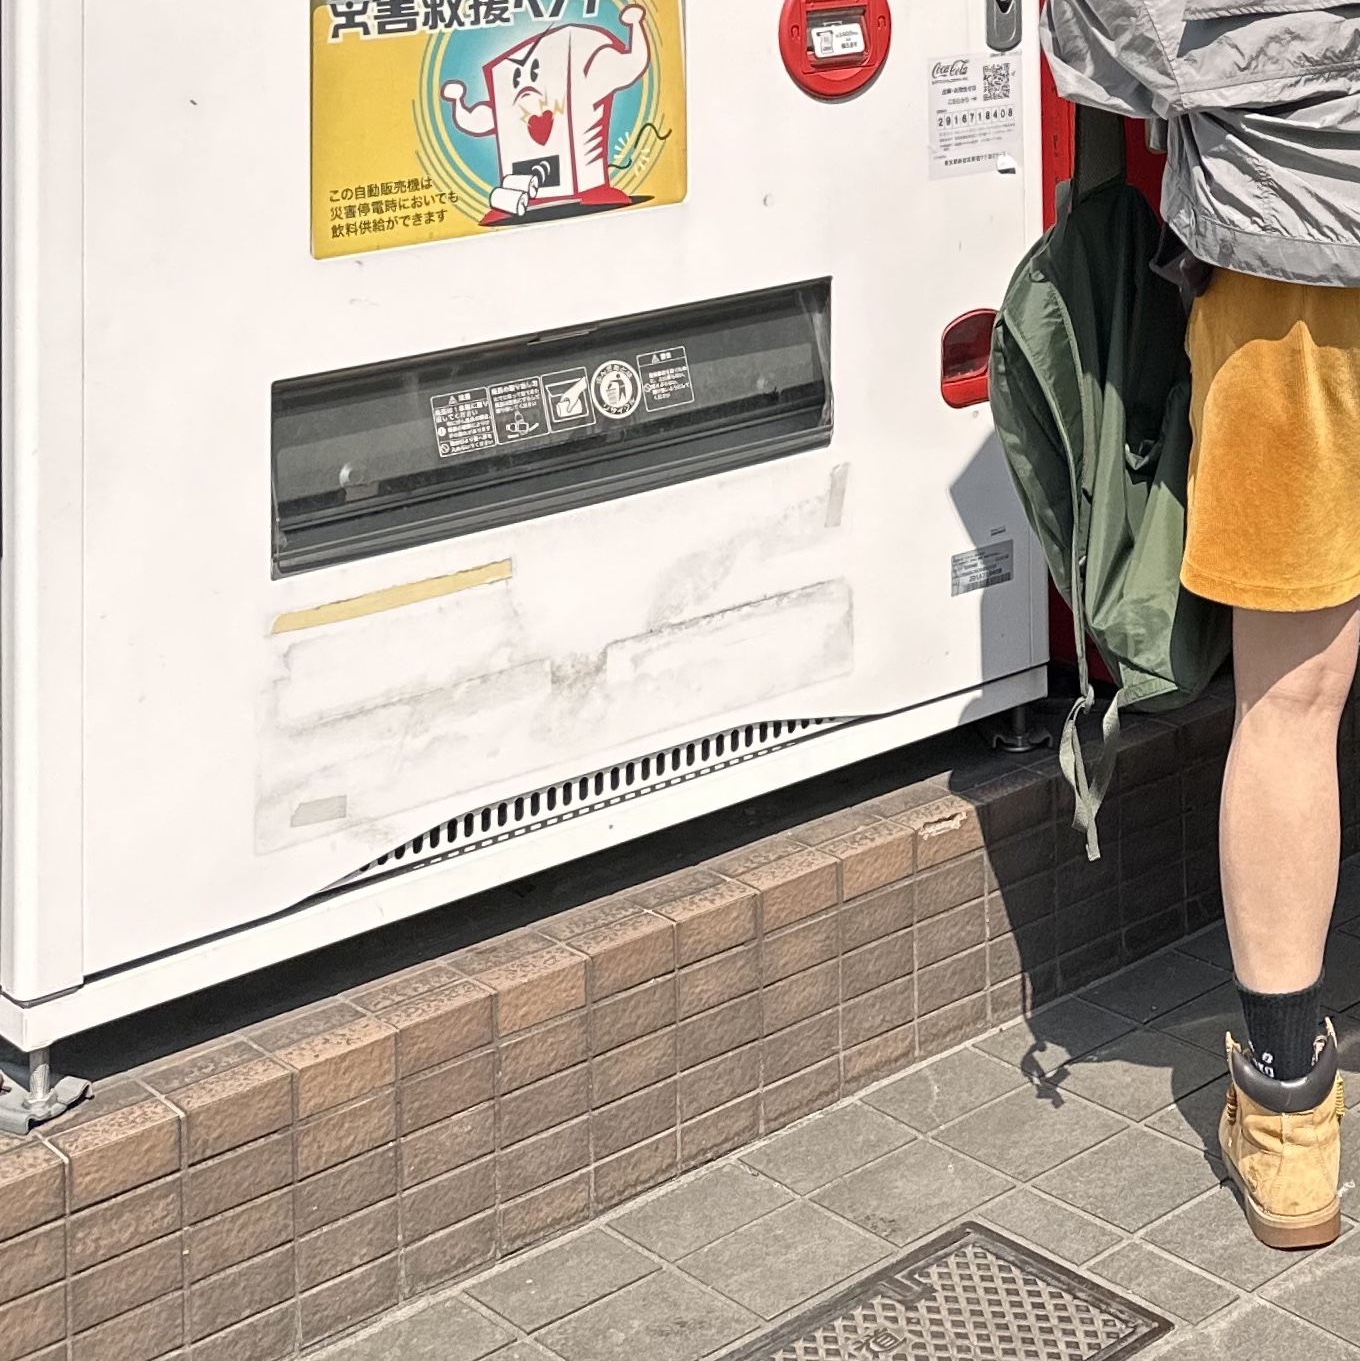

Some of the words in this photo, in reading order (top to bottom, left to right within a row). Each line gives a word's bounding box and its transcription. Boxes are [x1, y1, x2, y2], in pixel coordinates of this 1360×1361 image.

[932, 59, 970, 79] Coca-Cola
[938, 107, 1014, 128] 2916718408
[329, 178, 433, 202] この自動販売機は
[330, 191, 460, 221] 災害停電時においても
[331, 209, 448, 238] 飲料供給ができます
